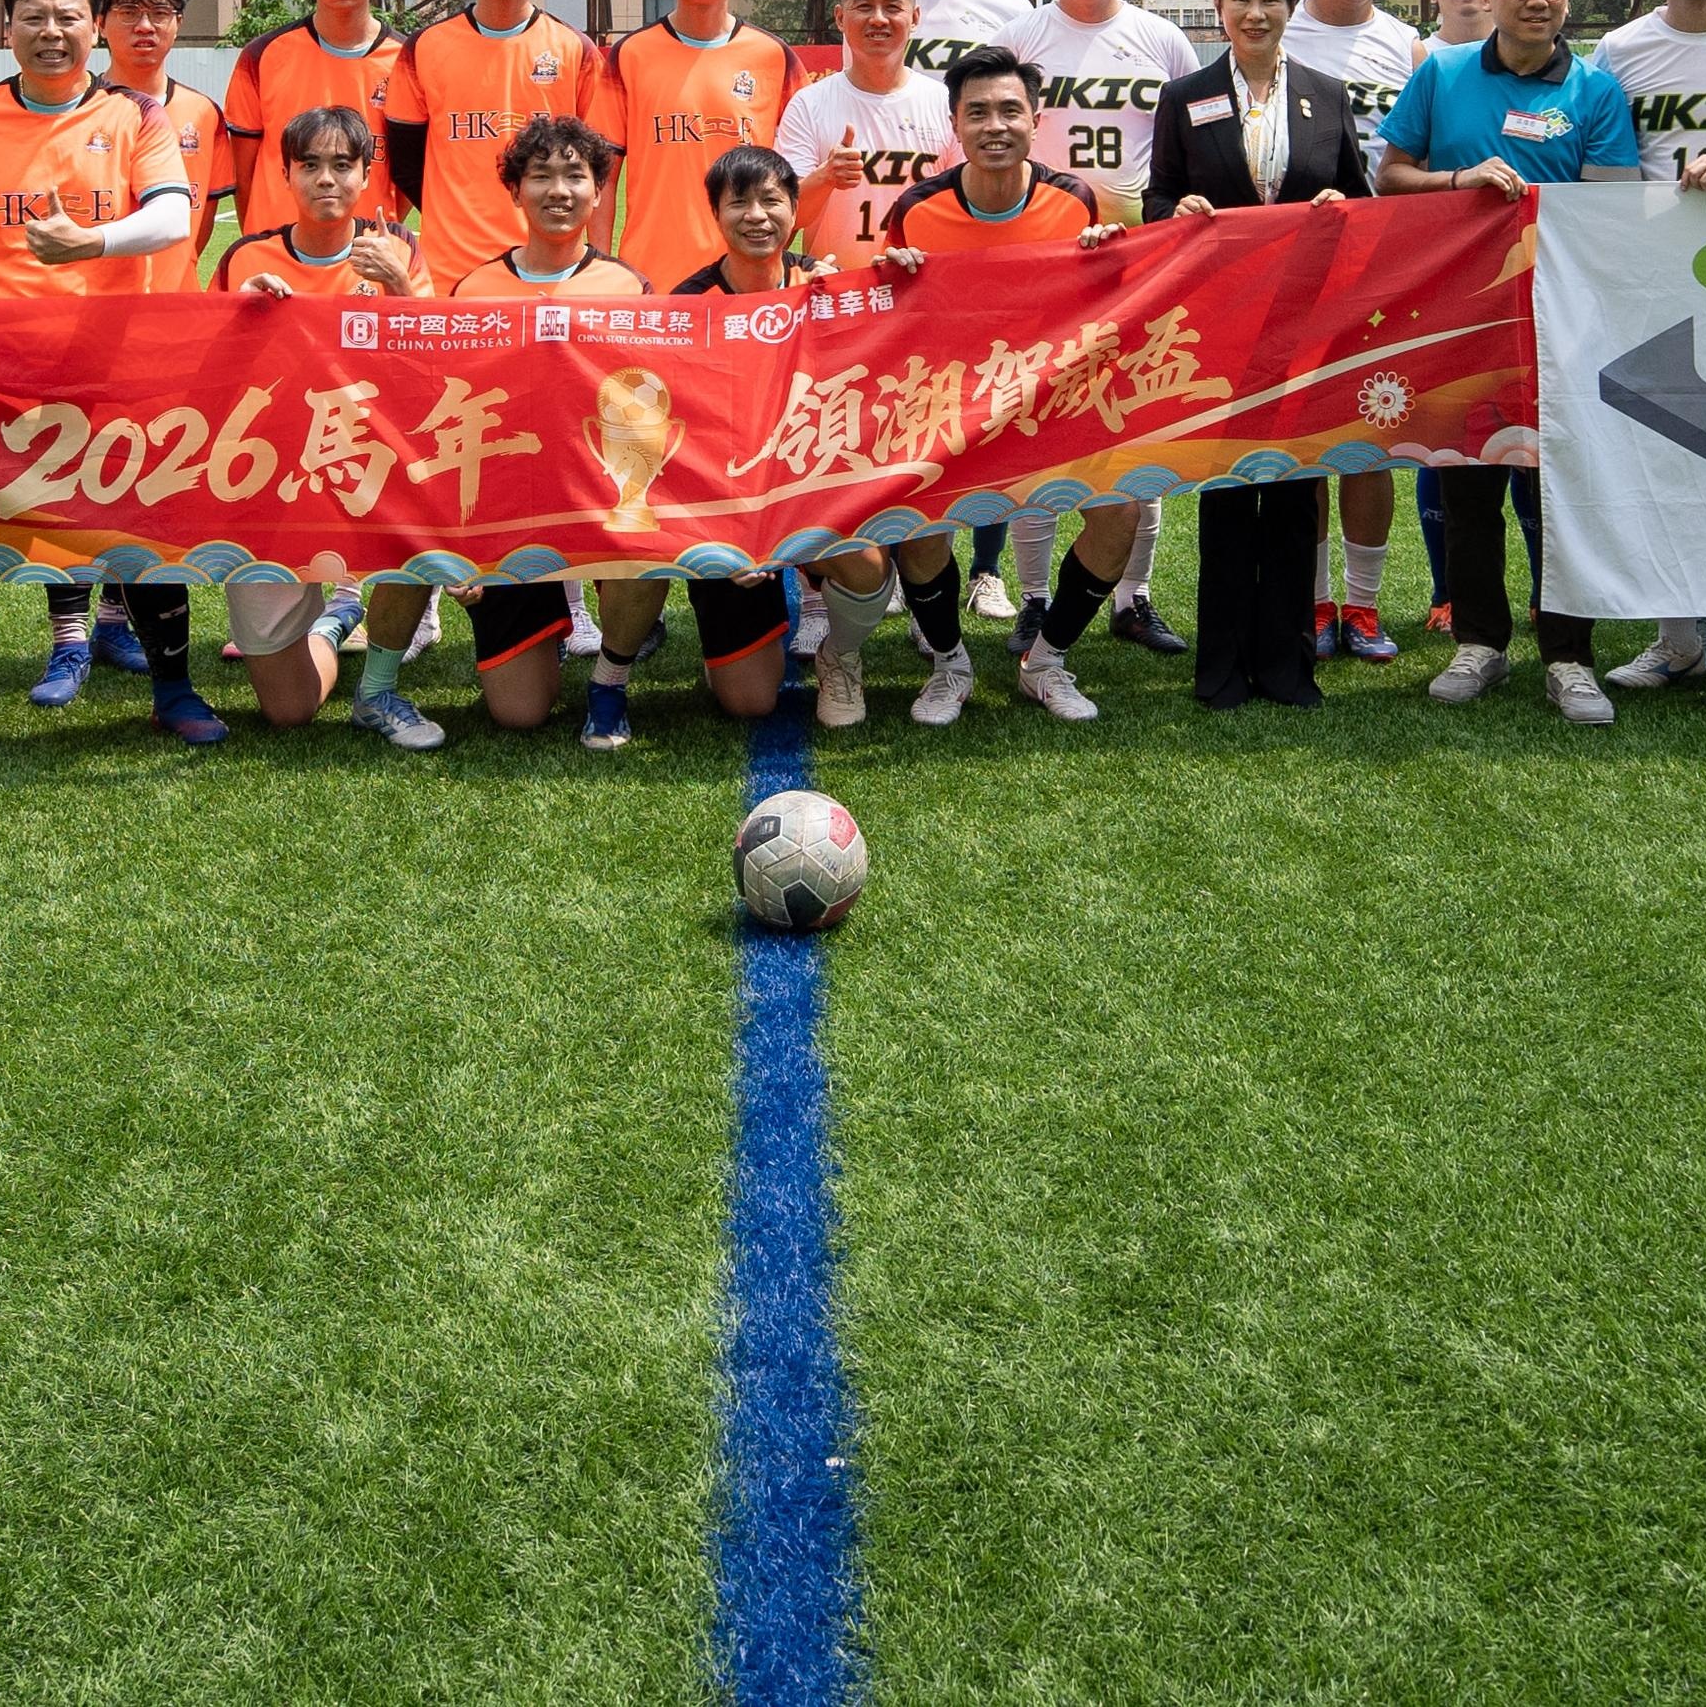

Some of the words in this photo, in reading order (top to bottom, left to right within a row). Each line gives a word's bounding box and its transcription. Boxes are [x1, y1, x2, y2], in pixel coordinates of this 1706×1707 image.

[904, 37, 988, 71] KI
[1068, 125, 1122, 170] 28
[860, 150, 939, 185] KIC
[387, 309, 513, 336] 中國海外
[578, 308, 694, 334] 中國建築
[387, 338, 434, 350] CHINA
[441, 336, 513, 350] OVERSEAS
[578, 334, 604, 345] CHINA
[606, 334, 628, 345] STATE
[628, 335, 694, 346] CONSTRUCTION
[726, 305, 1233, 483] 領潮賀歲盃
